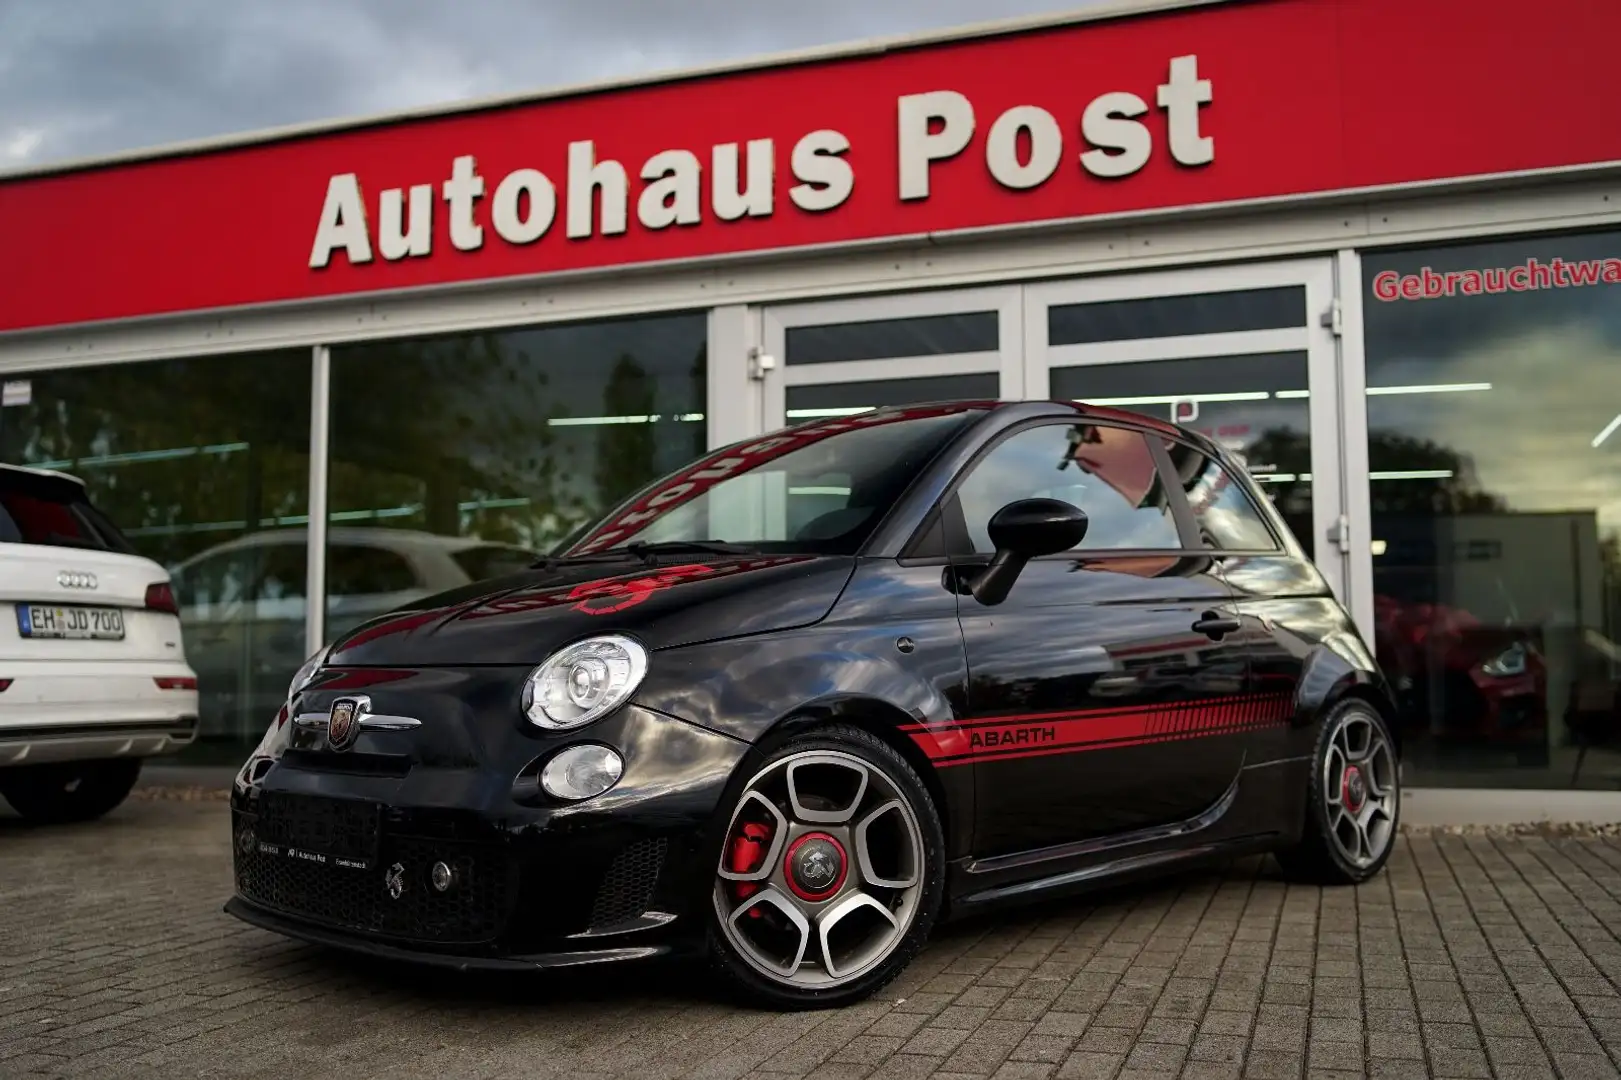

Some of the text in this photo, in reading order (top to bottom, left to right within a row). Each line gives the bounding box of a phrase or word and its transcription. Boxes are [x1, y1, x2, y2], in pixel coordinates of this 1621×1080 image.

[308, 54, 1215, 268] Autohaus Post
[1373, 257, 1621, 301] Gebrauchtwa
[31, 608, 121, 632] EH JD 700
[969, 726, 1055, 748] ABARTH
